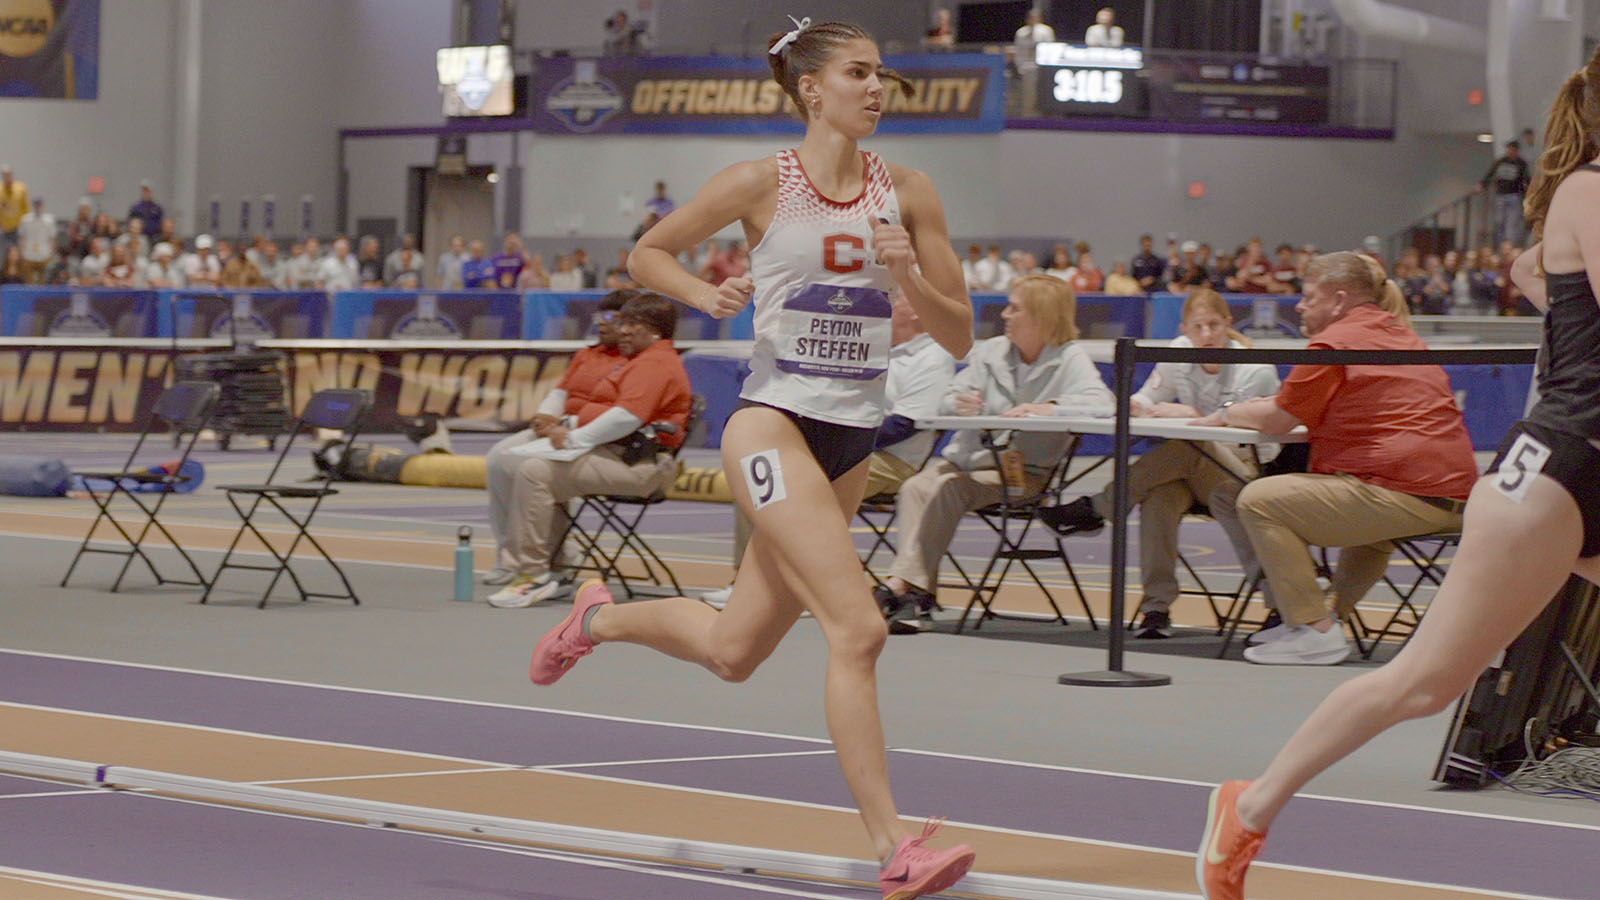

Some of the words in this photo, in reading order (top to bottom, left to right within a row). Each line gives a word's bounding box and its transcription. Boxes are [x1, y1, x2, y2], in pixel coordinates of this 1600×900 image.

[631, 79, 782, 115] OFFICIALS
[823, 232, 865, 275] C
[810, 317, 863, 337] PEYTON
[795, 337, 871, 362] STEFFEN
[750, 455, 775, 504] 9
[1499, 442, 1540, 492] 5
